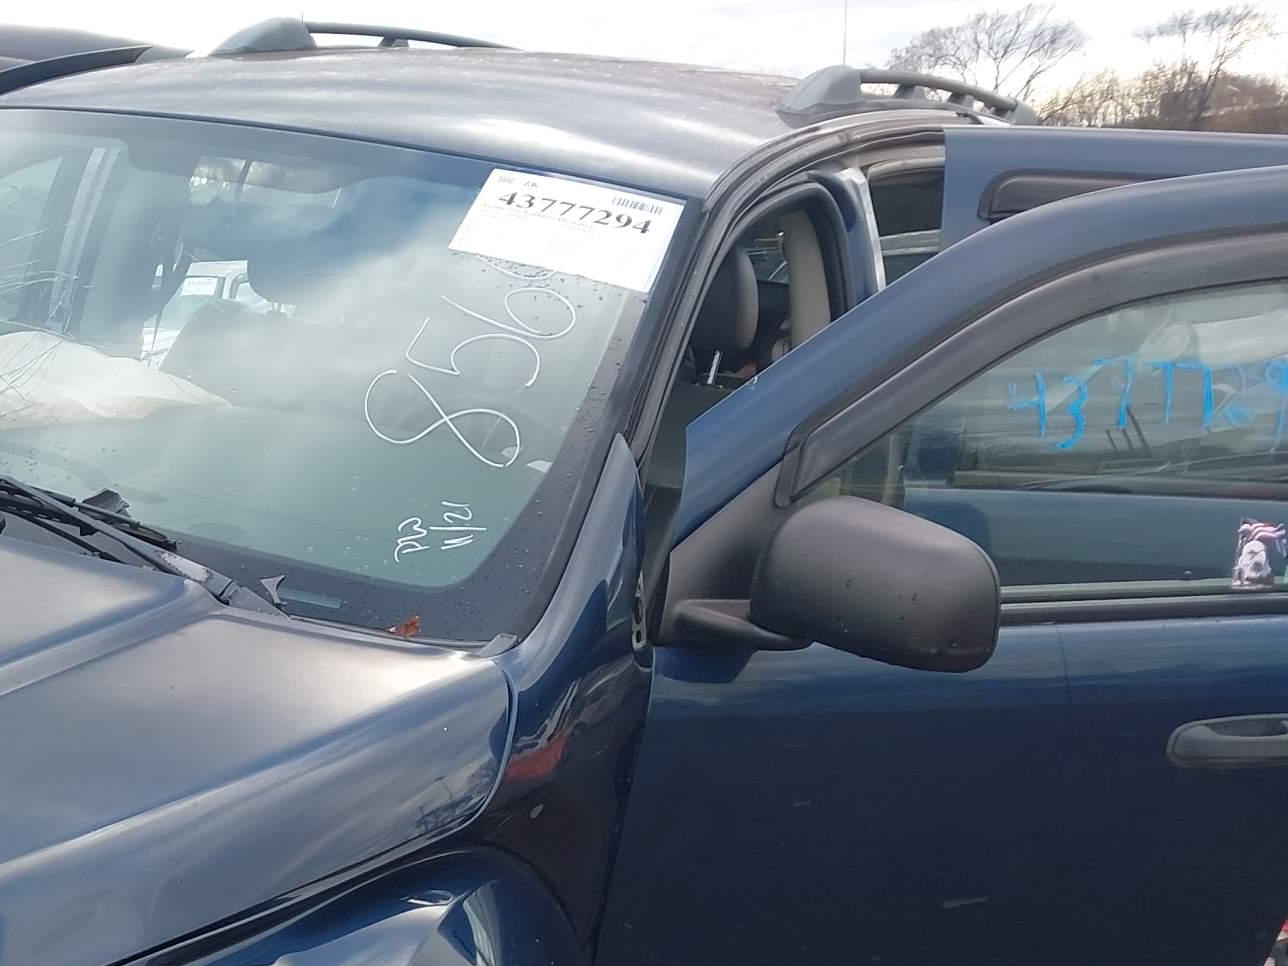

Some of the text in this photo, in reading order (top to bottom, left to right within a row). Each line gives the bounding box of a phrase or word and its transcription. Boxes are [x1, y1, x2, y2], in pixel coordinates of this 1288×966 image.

[497, 191, 653, 235] 43777294
[364, 252, 577, 468] 856
[428, 500, 487, 551] 11/21
